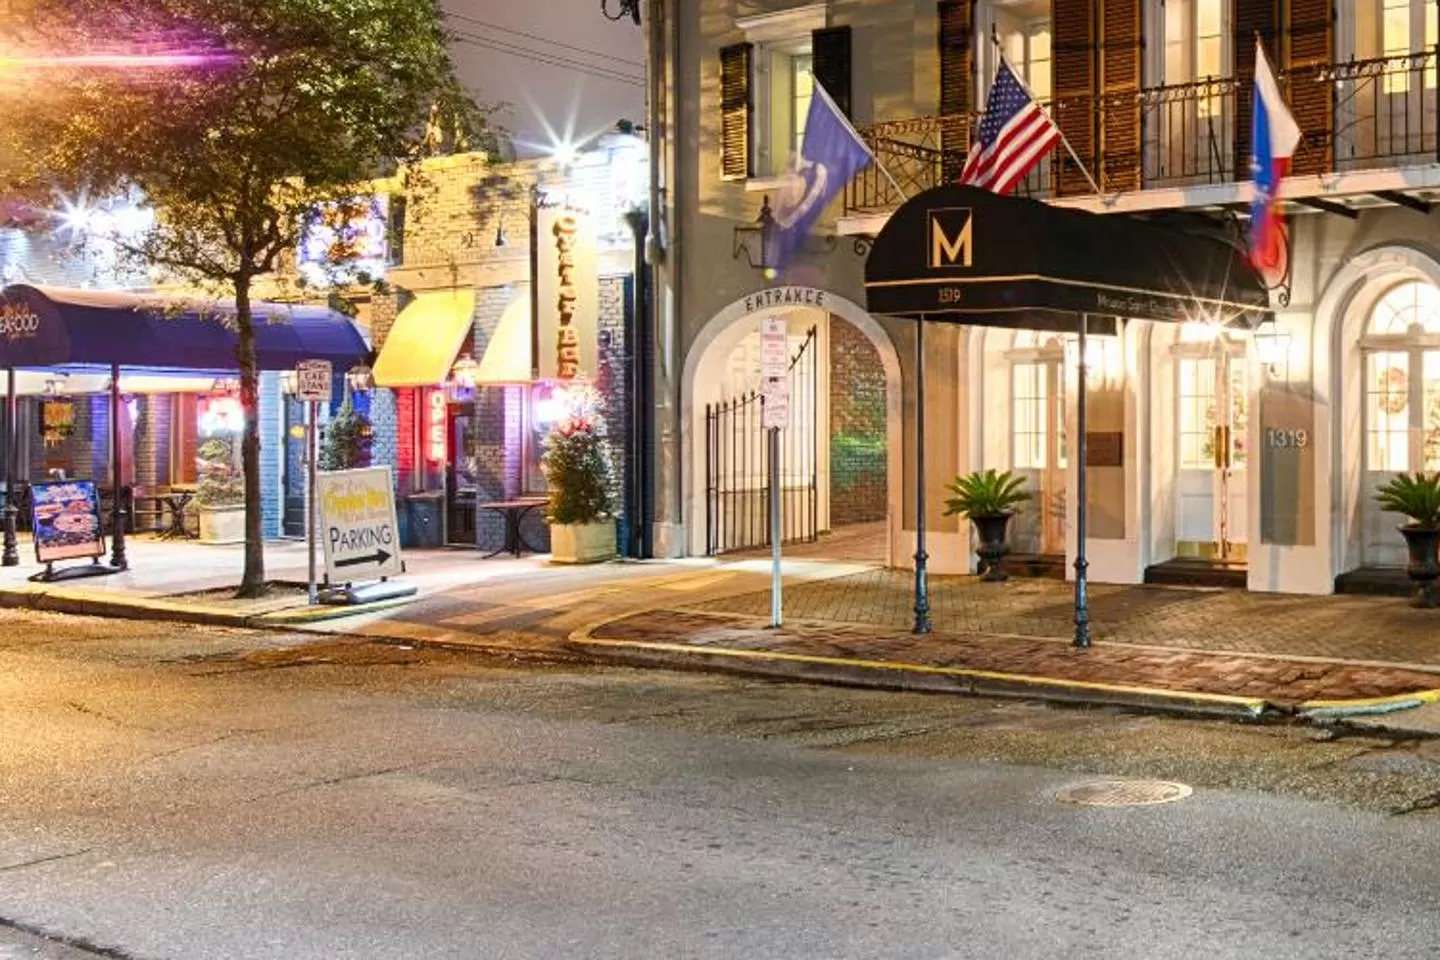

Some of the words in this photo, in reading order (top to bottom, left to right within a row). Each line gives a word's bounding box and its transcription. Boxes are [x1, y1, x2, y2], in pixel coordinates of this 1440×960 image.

[932, 215, 972, 268] M
[745, 288, 825, 313] ENTRANCE
[1268, 428, 1307, 448] 1319
[329, 524, 393, 553] PARKING
